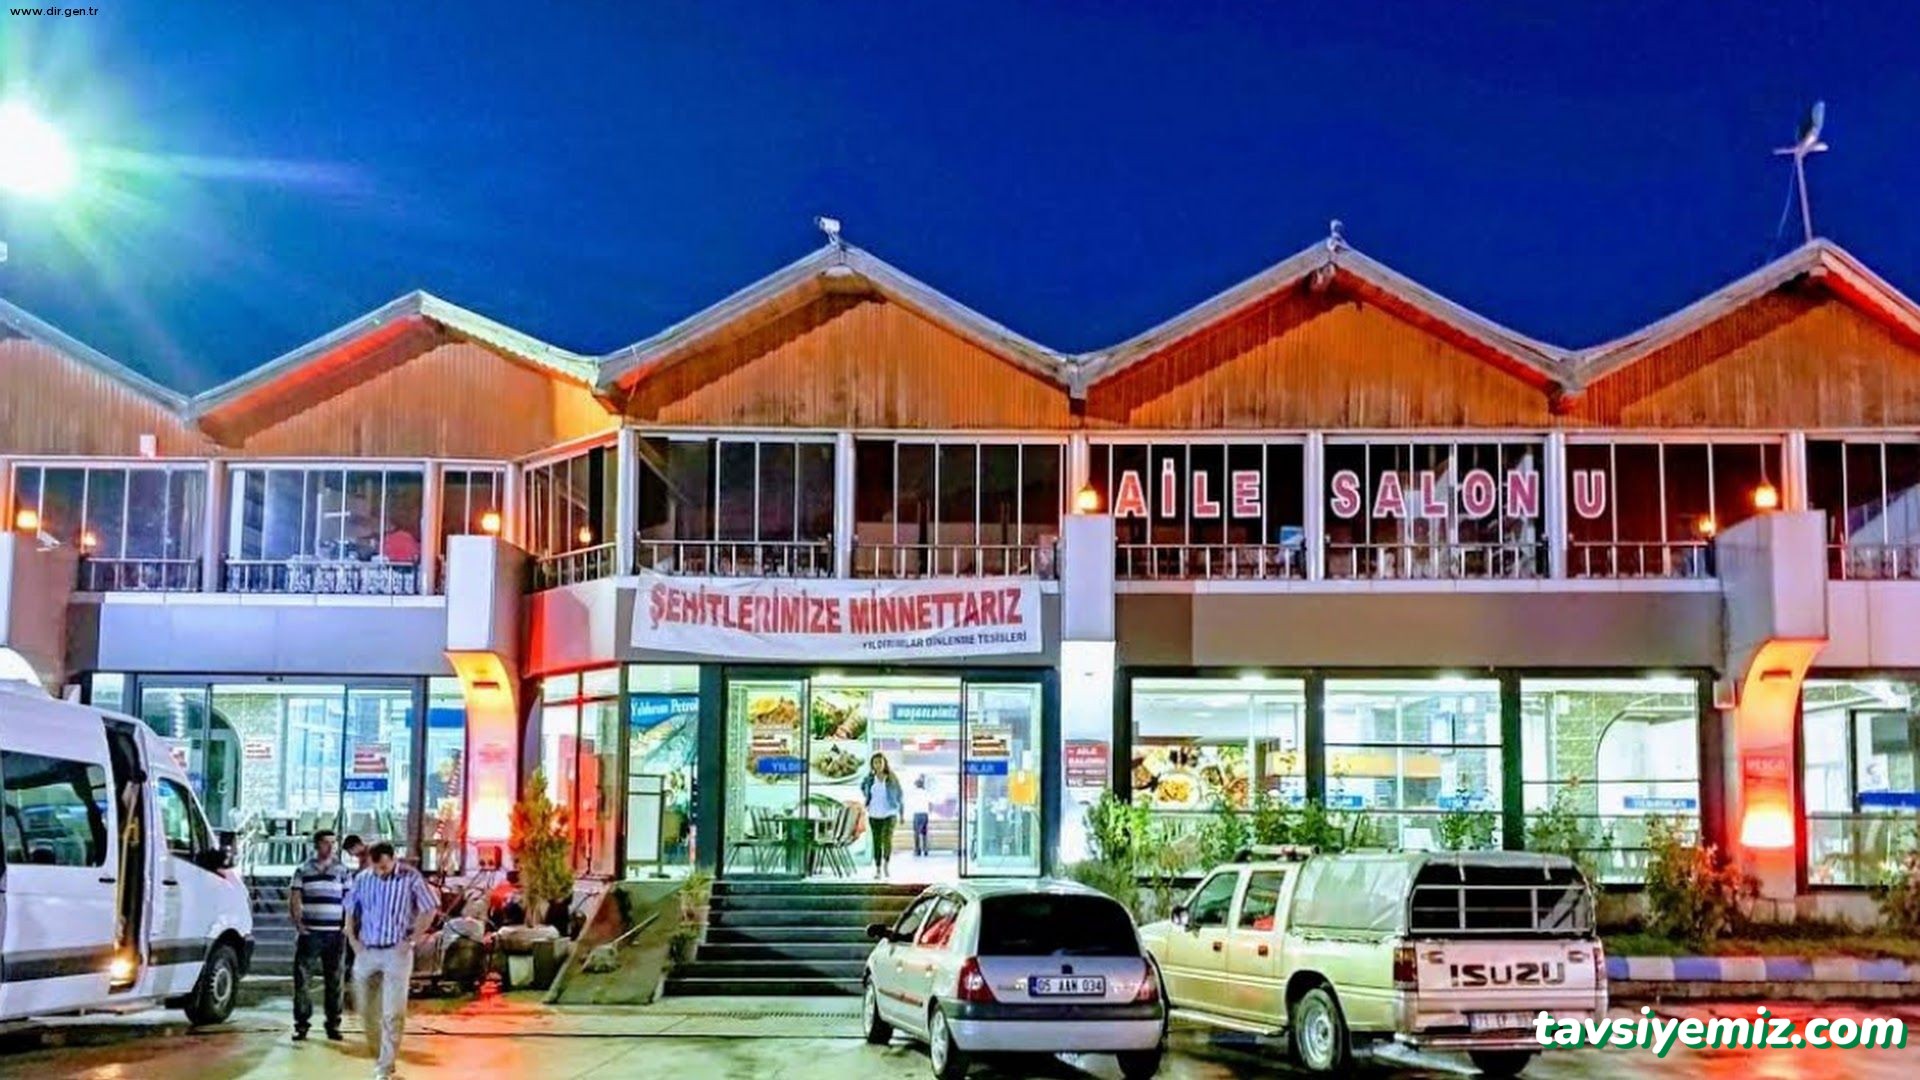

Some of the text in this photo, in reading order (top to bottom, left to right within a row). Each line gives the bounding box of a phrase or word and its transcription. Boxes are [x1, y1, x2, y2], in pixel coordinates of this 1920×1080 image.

[1114, 457, 1261, 518] AİLE
[650, 582, 1023, 635] ŞEHİTLERİMİZE MİNNETTARIZ
[1450, 963, 1566, 987] ISUZU
